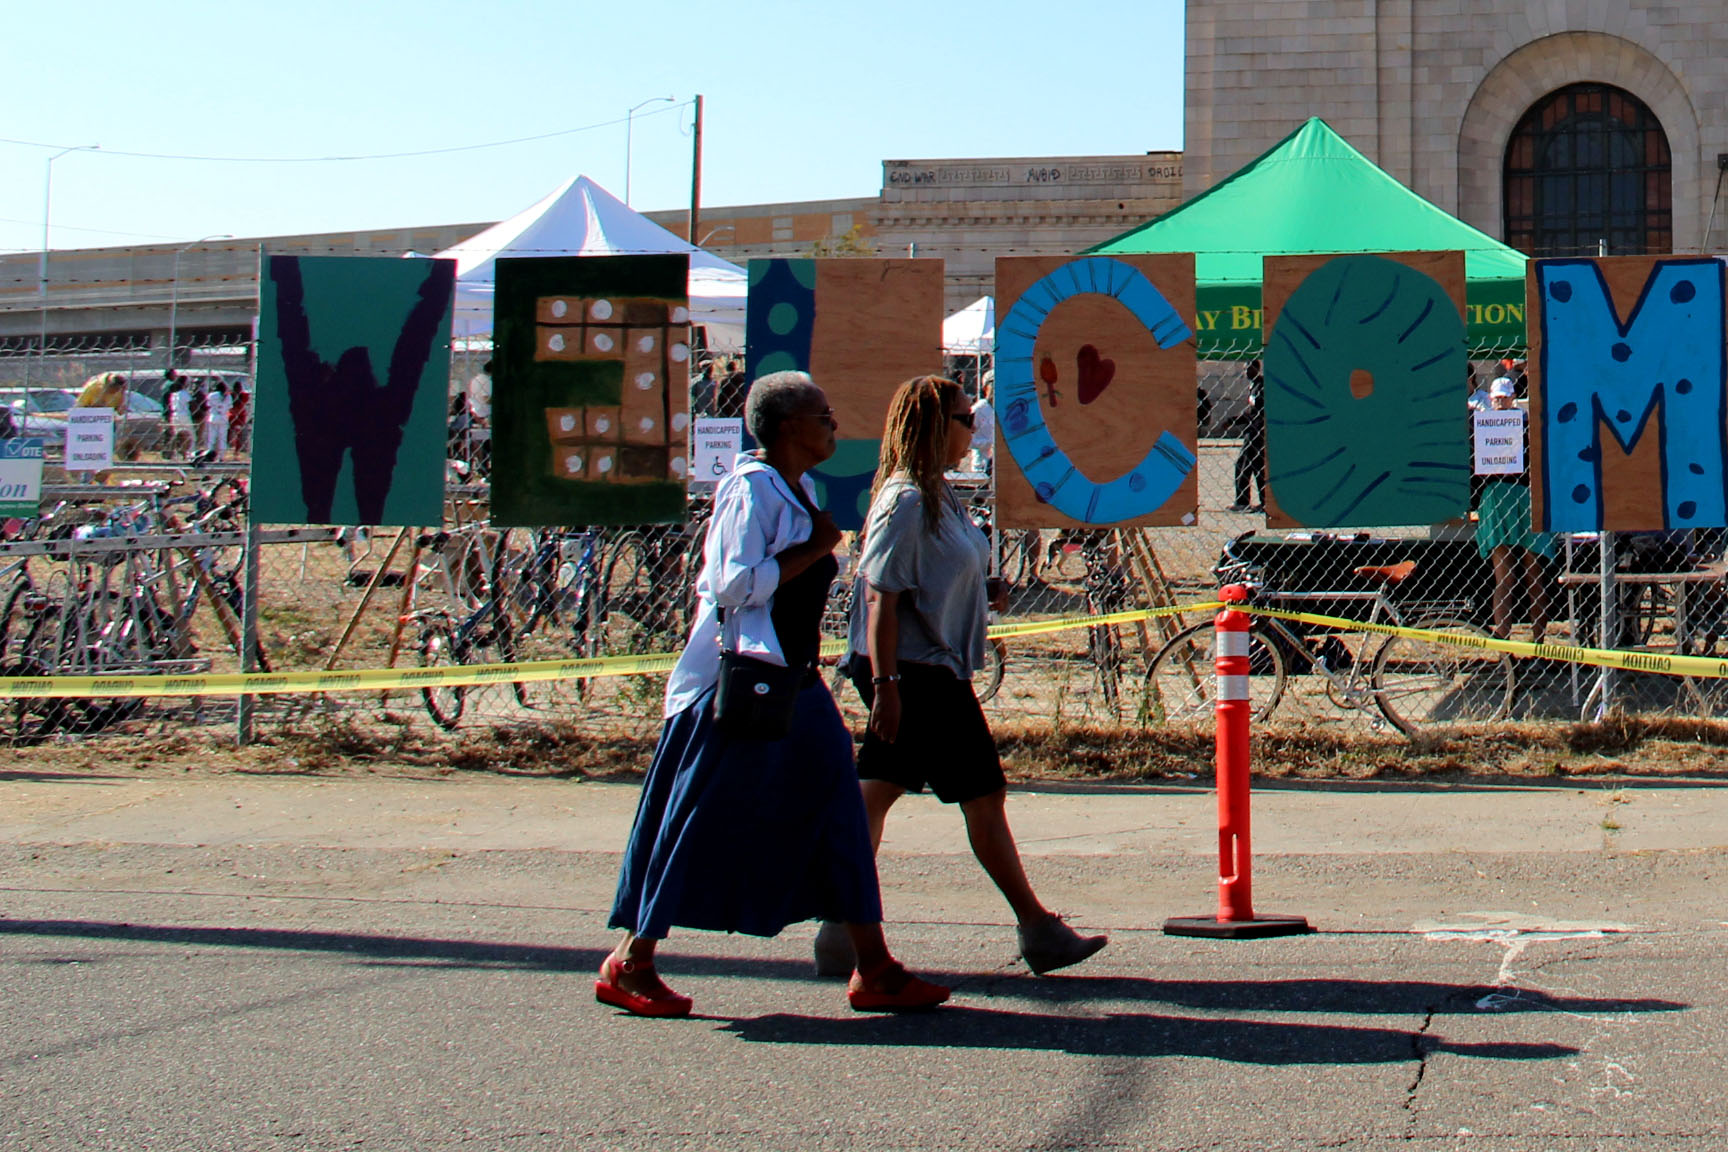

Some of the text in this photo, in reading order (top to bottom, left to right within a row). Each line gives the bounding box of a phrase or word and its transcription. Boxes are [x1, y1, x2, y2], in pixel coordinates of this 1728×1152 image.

[71, 415, 112, 423] HANDICAPPED
[1476, 418, 1521, 427] HANDICAPPED
[697, 425, 740, 434] HANDICAPPED
[77, 433, 104, 442] PARKING
[1485, 437, 1513, 446] PARKING
[705, 440, 732, 449] PARKING
[1481, 455, 1518, 465] UNLOADING
